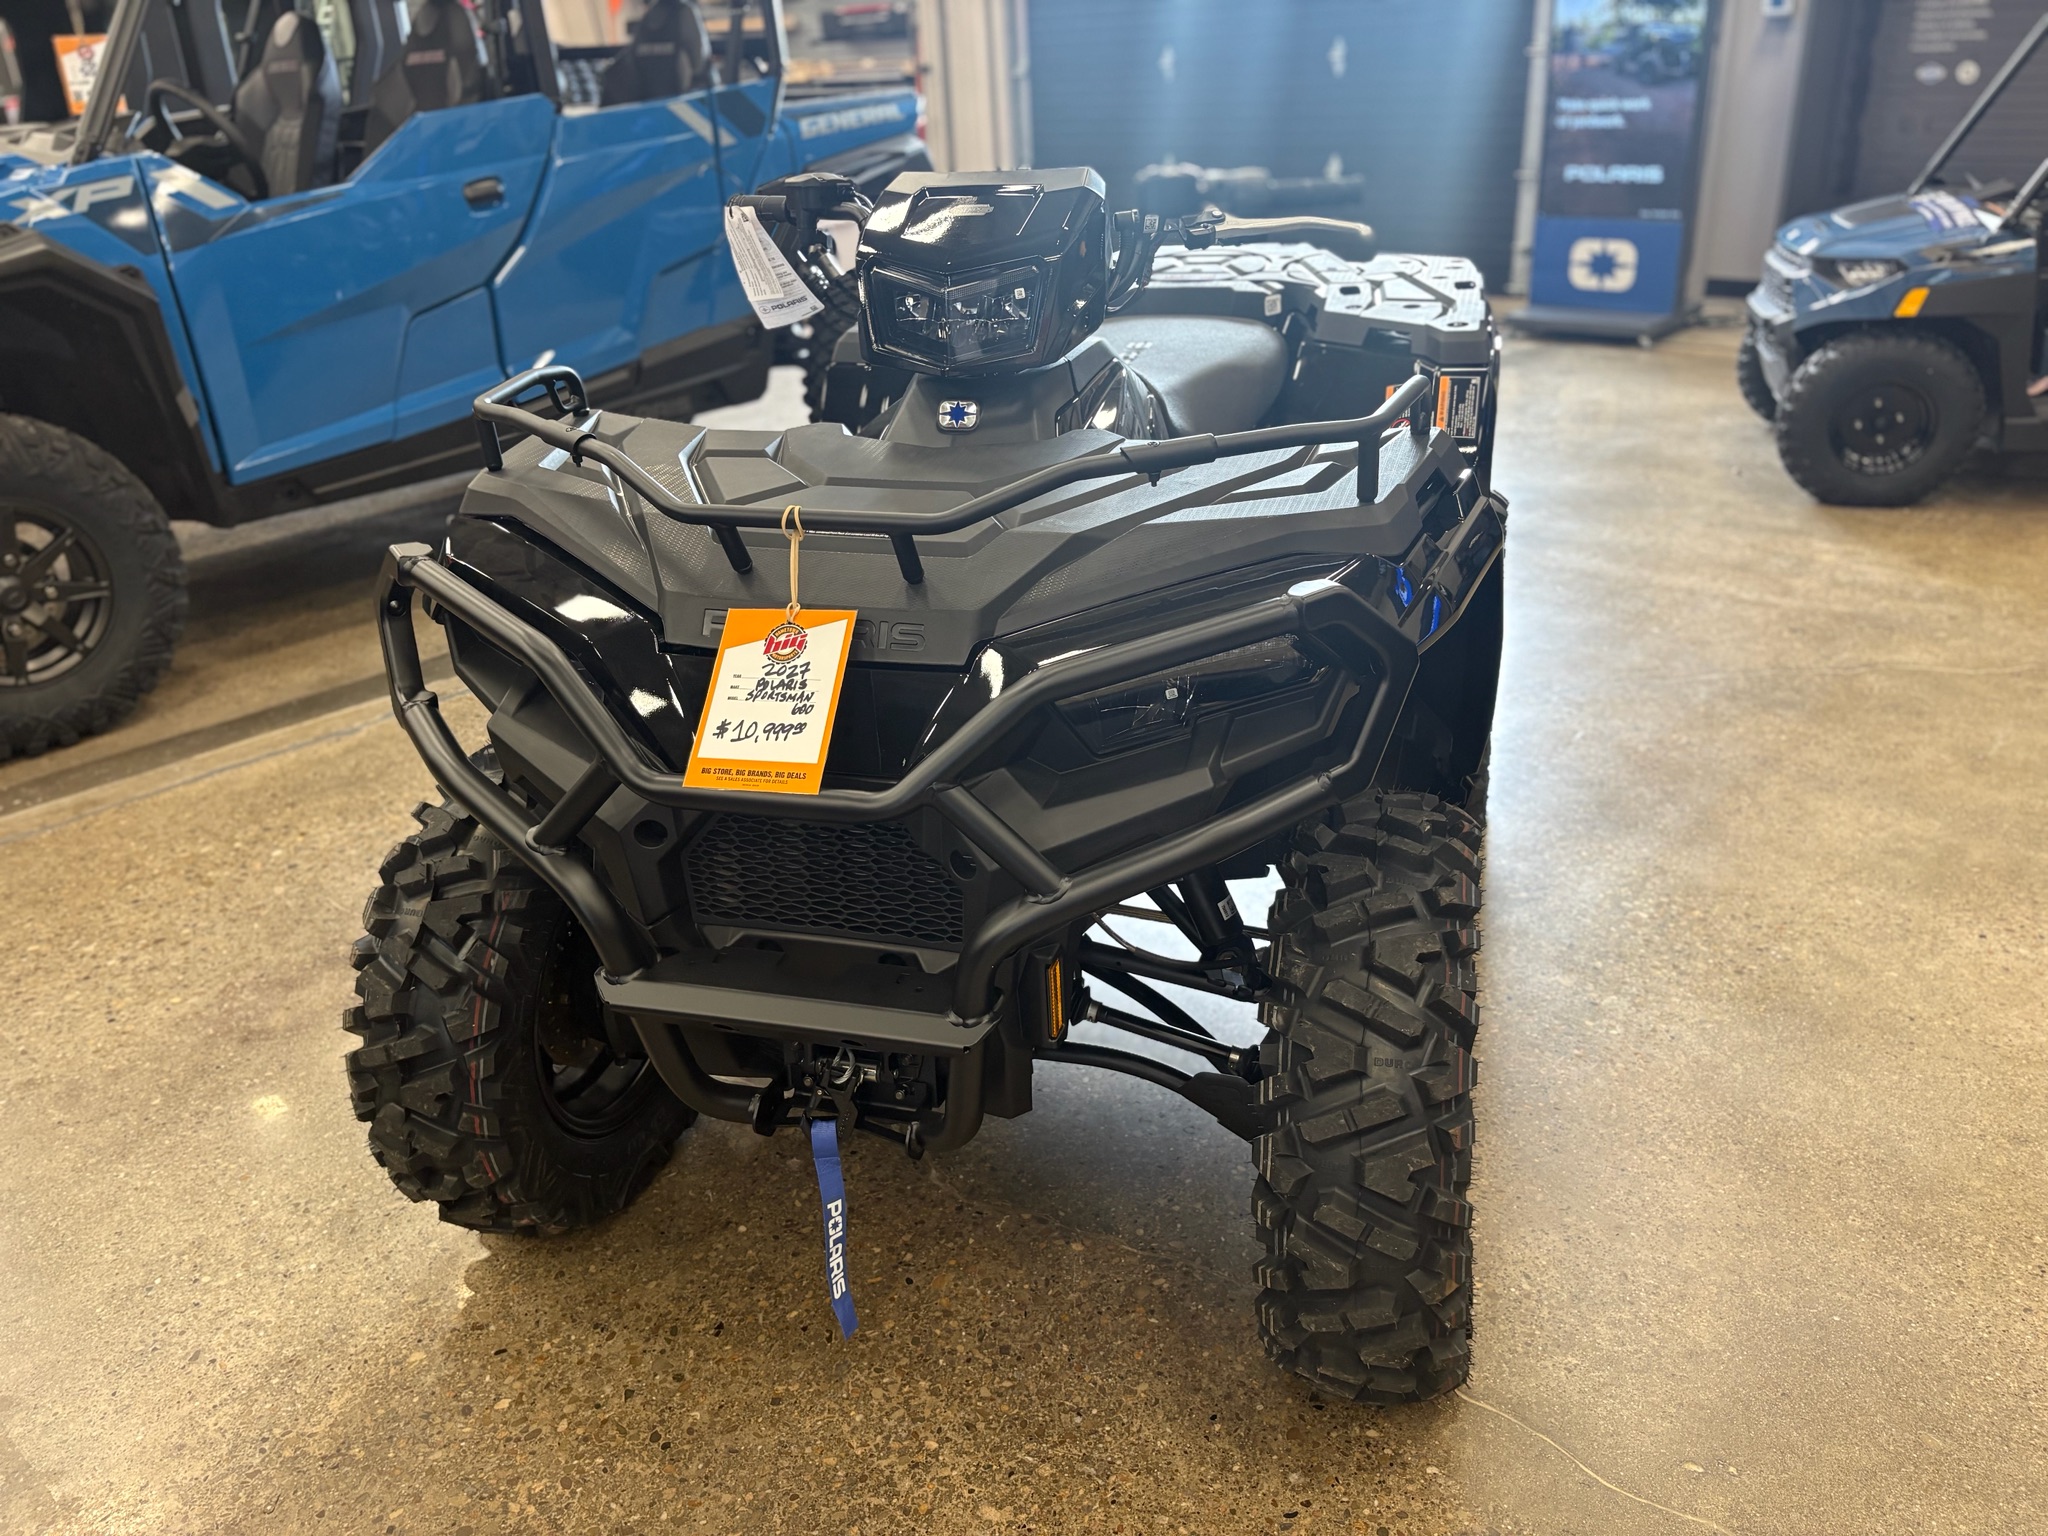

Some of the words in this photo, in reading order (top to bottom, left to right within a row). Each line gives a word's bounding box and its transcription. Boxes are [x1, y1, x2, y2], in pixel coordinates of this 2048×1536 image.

[799, 103, 906, 140] GENERAL
[1563, 165, 1664, 184] POLARIS
[8, 175, 134, 224] XP
[771, 295, 808, 311] POLARIS
[761, 661, 811, 679] 2027
[755, 677, 808, 691] POLARIS
[745, 690, 815, 703] SPORTSMAN
[713, 768, 734, 776] STORE,
[747, 770, 773, 778] BRANDS,
[774, 771, 785, 779] BIG
[786, 772, 807, 780] DEALS
[827, 1198, 846, 1300] POLARIS
